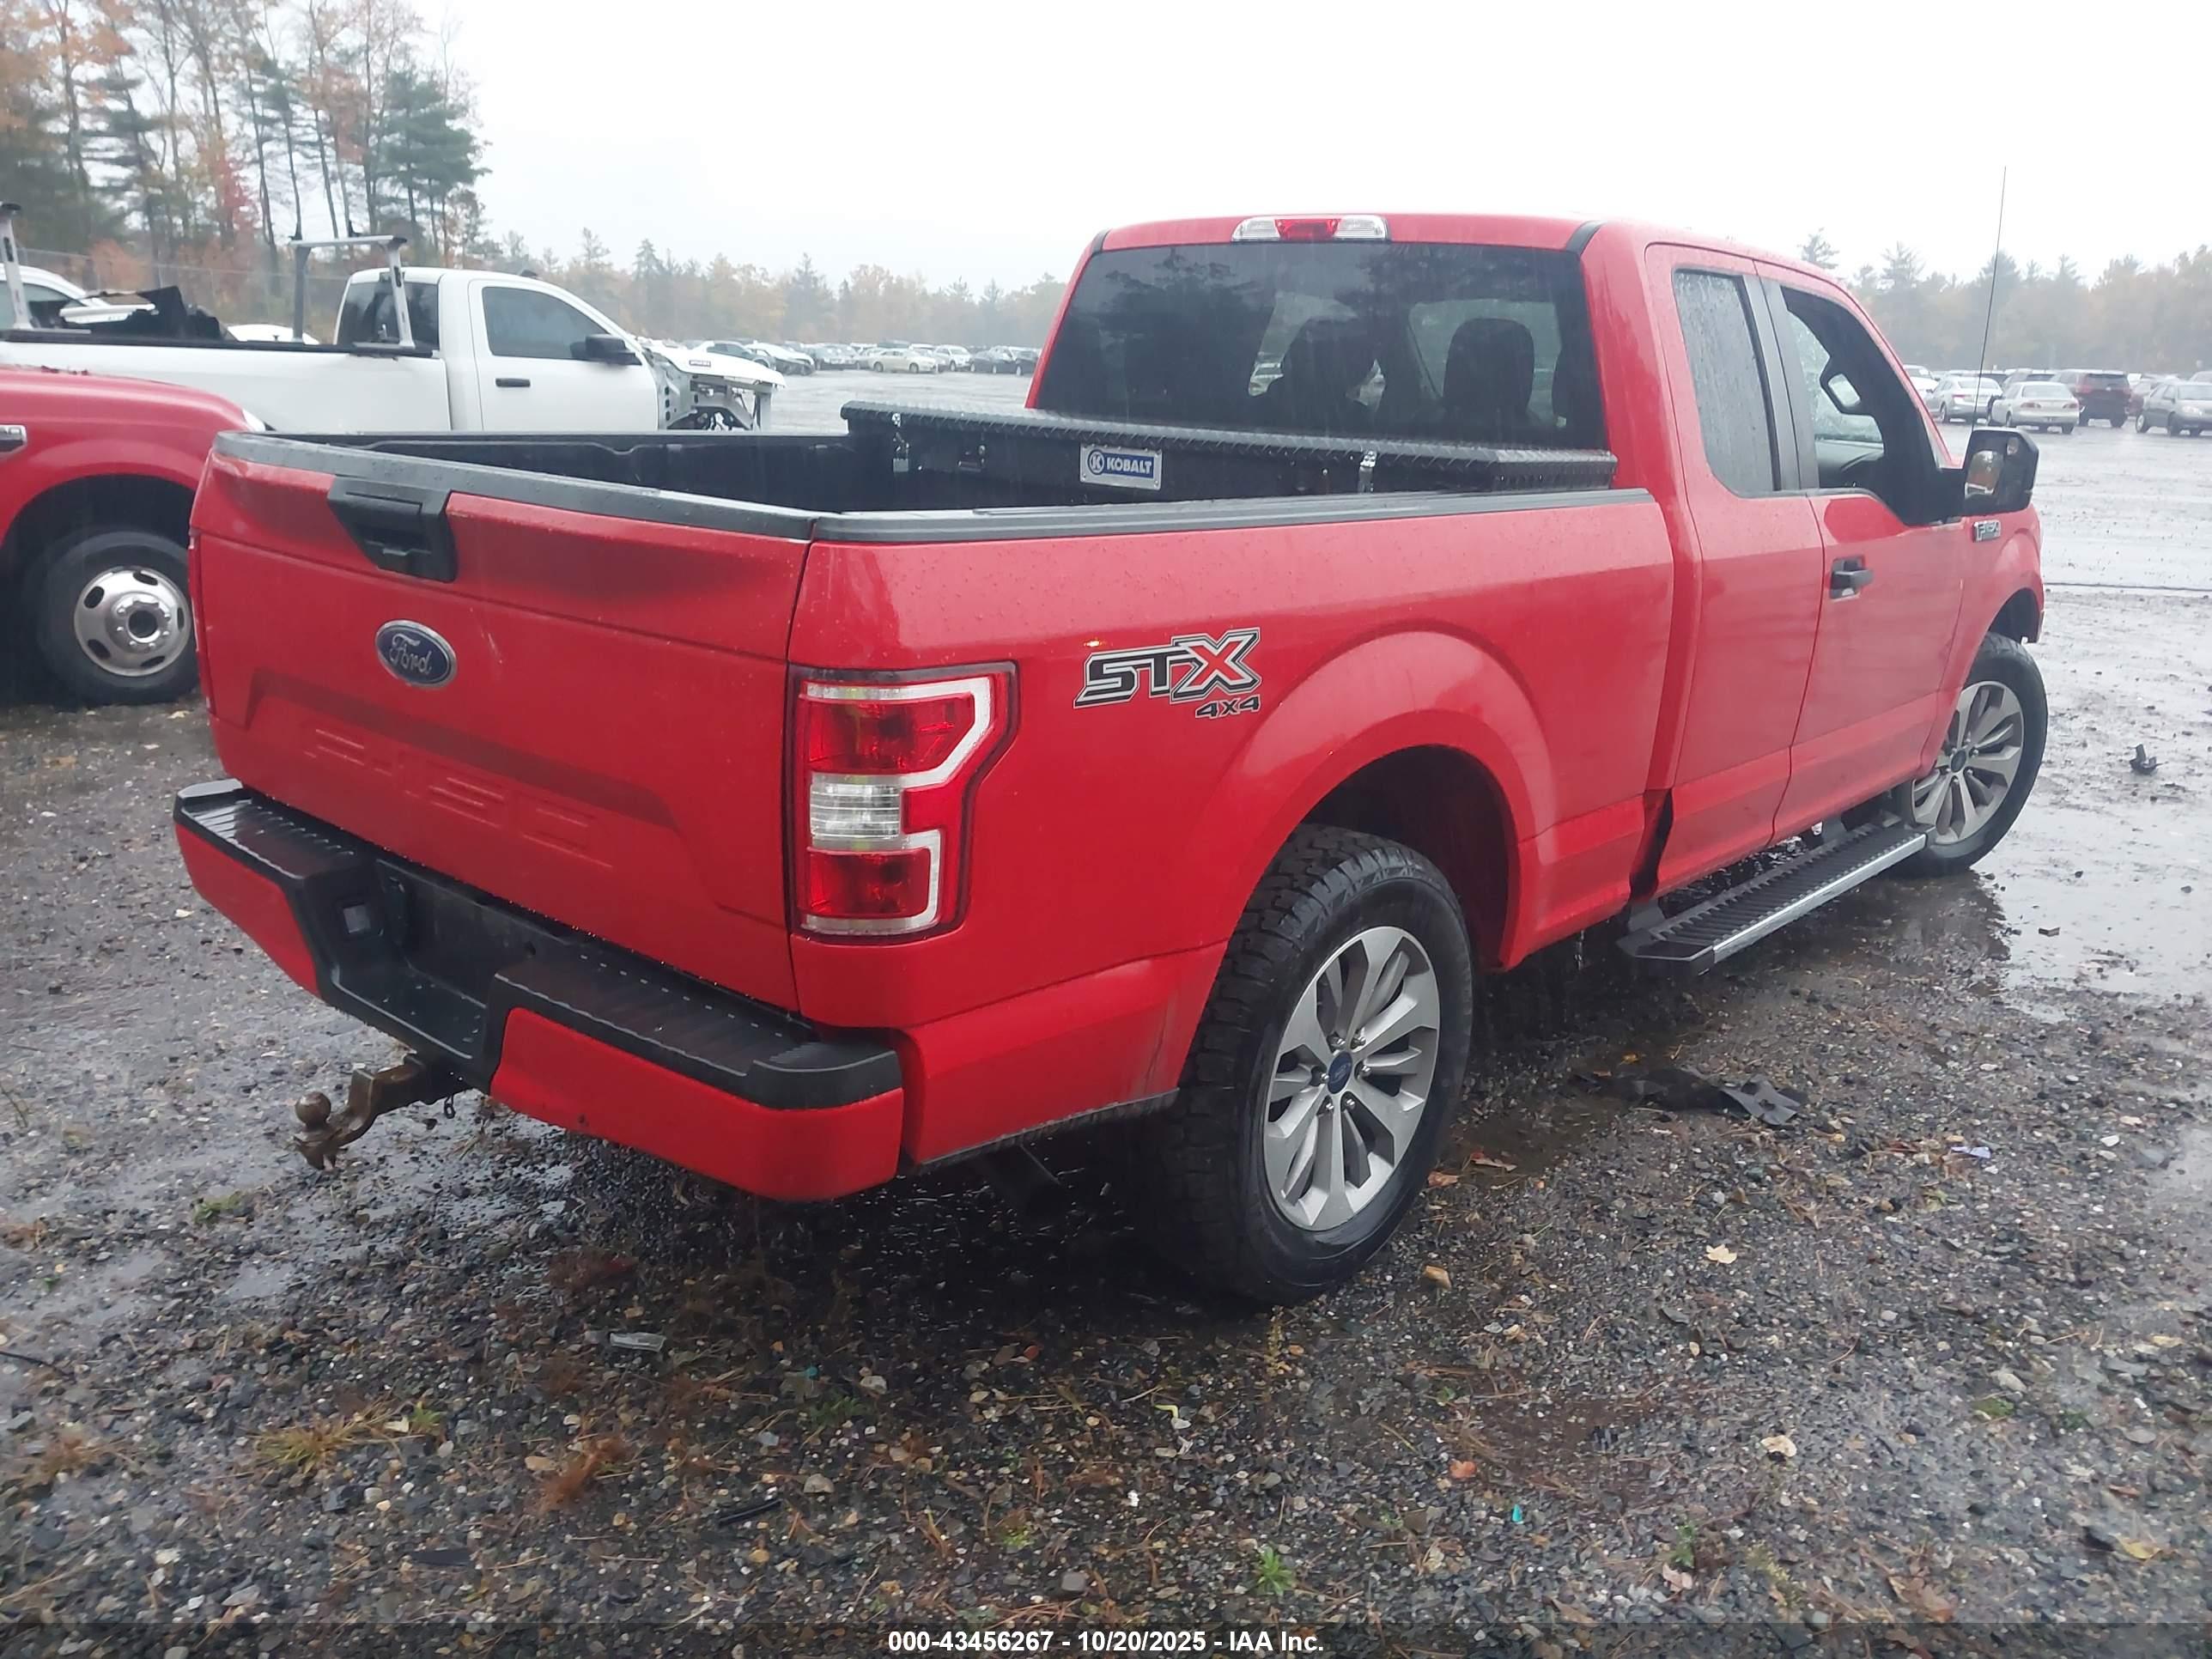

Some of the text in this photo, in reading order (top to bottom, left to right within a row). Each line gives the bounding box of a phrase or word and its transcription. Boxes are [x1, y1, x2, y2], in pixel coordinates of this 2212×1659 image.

[1106, 457, 1152, 474] KOBALT
[389, 633, 433, 675] Ford
[1073, 627, 1262, 709] STX
